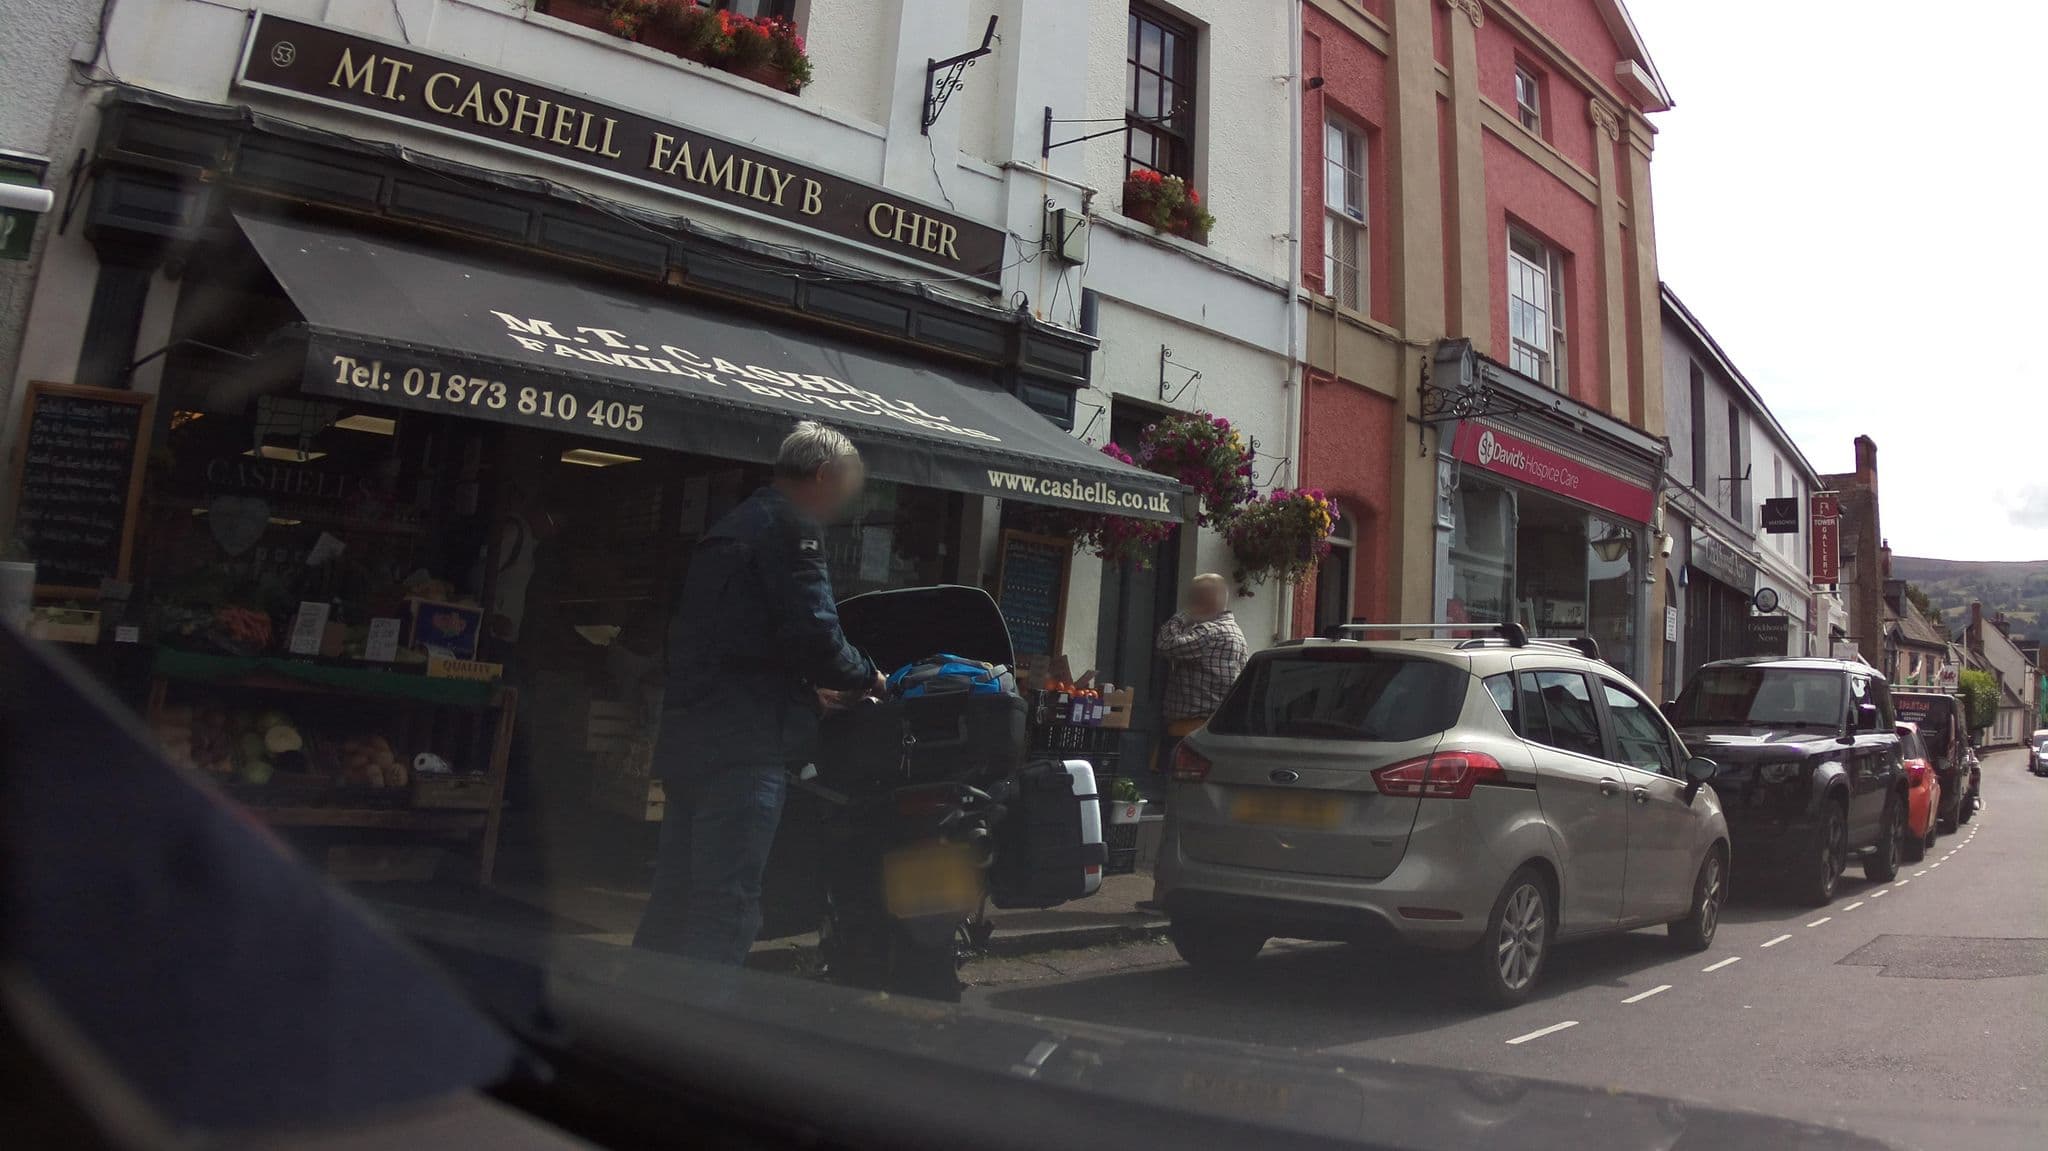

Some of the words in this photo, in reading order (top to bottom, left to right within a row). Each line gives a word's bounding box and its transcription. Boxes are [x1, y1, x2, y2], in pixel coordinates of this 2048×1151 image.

[275, 46, 293, 62] 53
[328, 47, 413, 102] MT.
[424, 72, 622, 159] CASHELL
[649, 132, 797, 206] FAMILY
[506, 333, 727, 386] FAMILY
[333, 355, 392, 391] Tel:
[403, 368, 507, 409] 01873
[518, 387, 577, 420] 810
[587, 400, 645, 432] 405
[1493, 443, 1526, 470] David's
[1526, 457, 1560, 482] Hospice
[1559, 467, 1580, 489] Care
[988, 470, 1171, 514] www.cashells.co.uk
[1814, 518, 1836, 526] TOWER
[1746, 623, 1789, 632] Crickhowell
[1758, 632, 1778, 641] News
